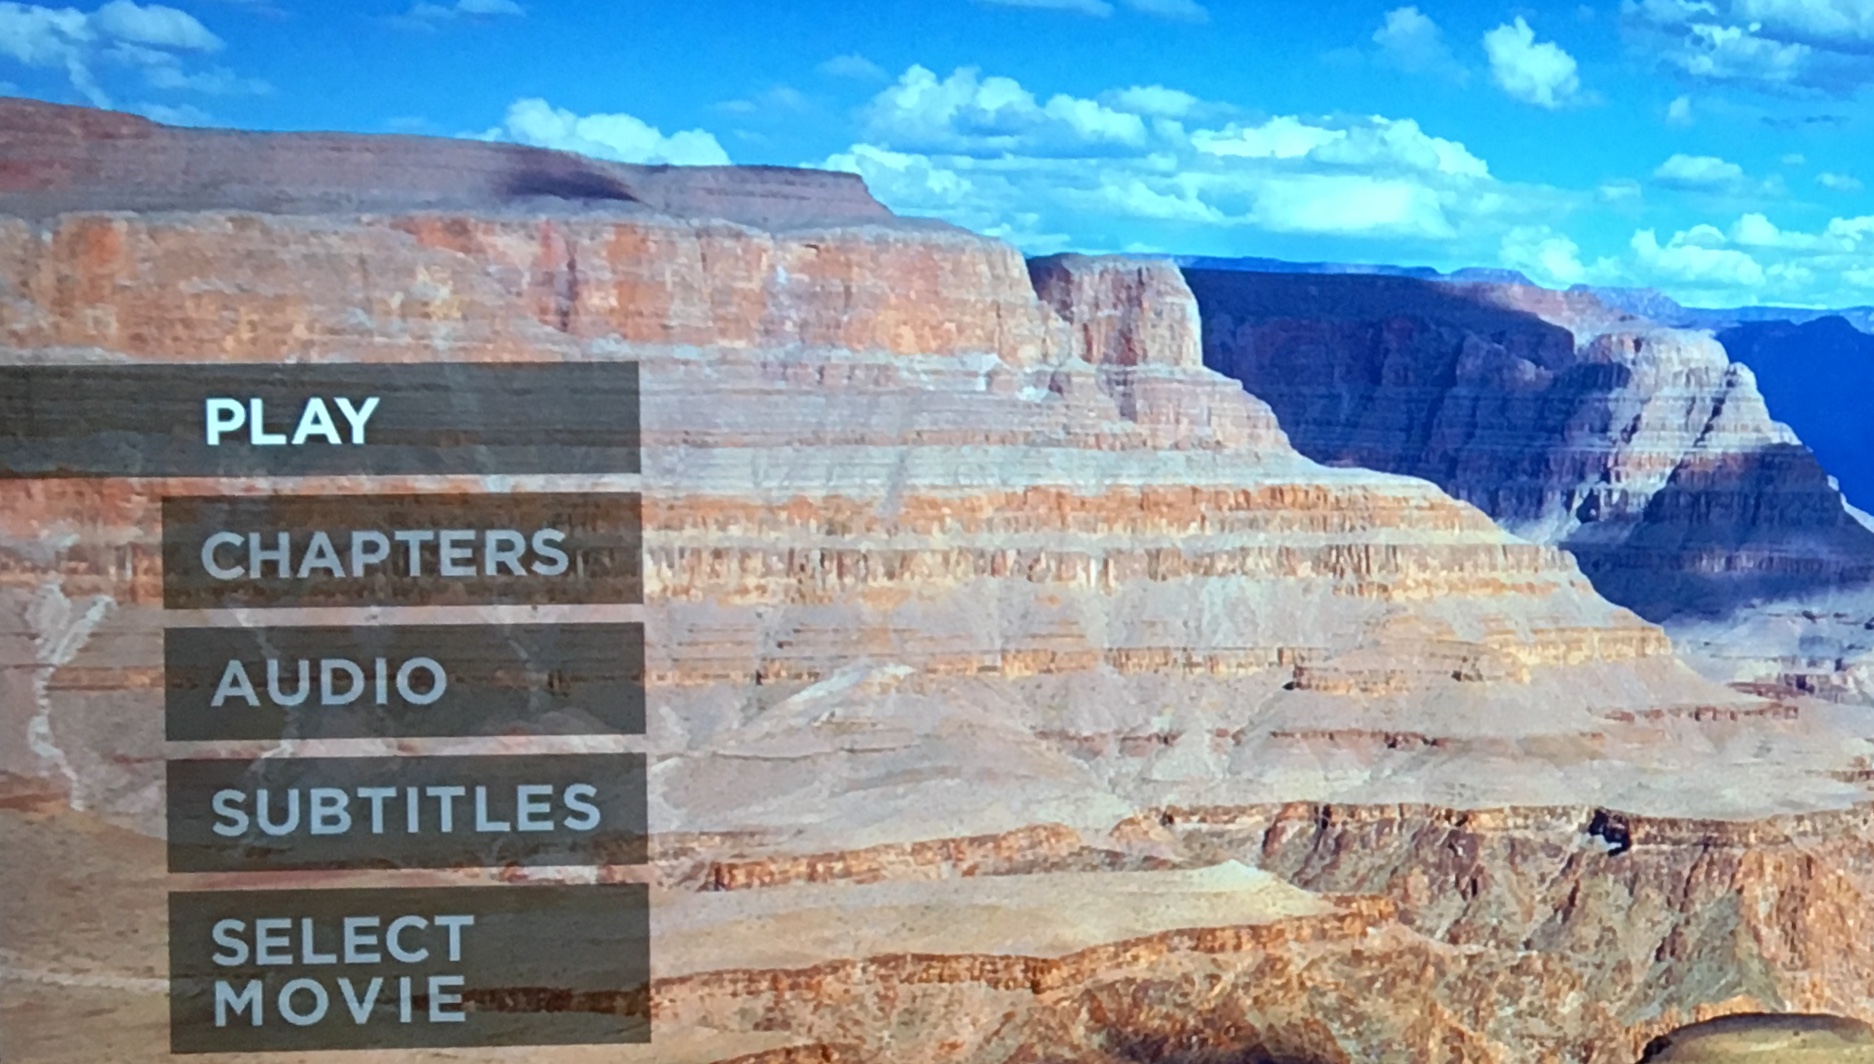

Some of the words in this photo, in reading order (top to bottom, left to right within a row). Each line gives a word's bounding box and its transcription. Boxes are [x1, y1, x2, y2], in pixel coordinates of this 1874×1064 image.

[206, 397, 380, 446] PLAY
[201, 528, 570, 580] CHAPTERS
[211, 656, 447, 708] AUDIO
[212, 784, 602, 836] SUBTITLES
[212, 914, 475, 966] SELECT
[214, 975, 467, 1027] MOVIE
